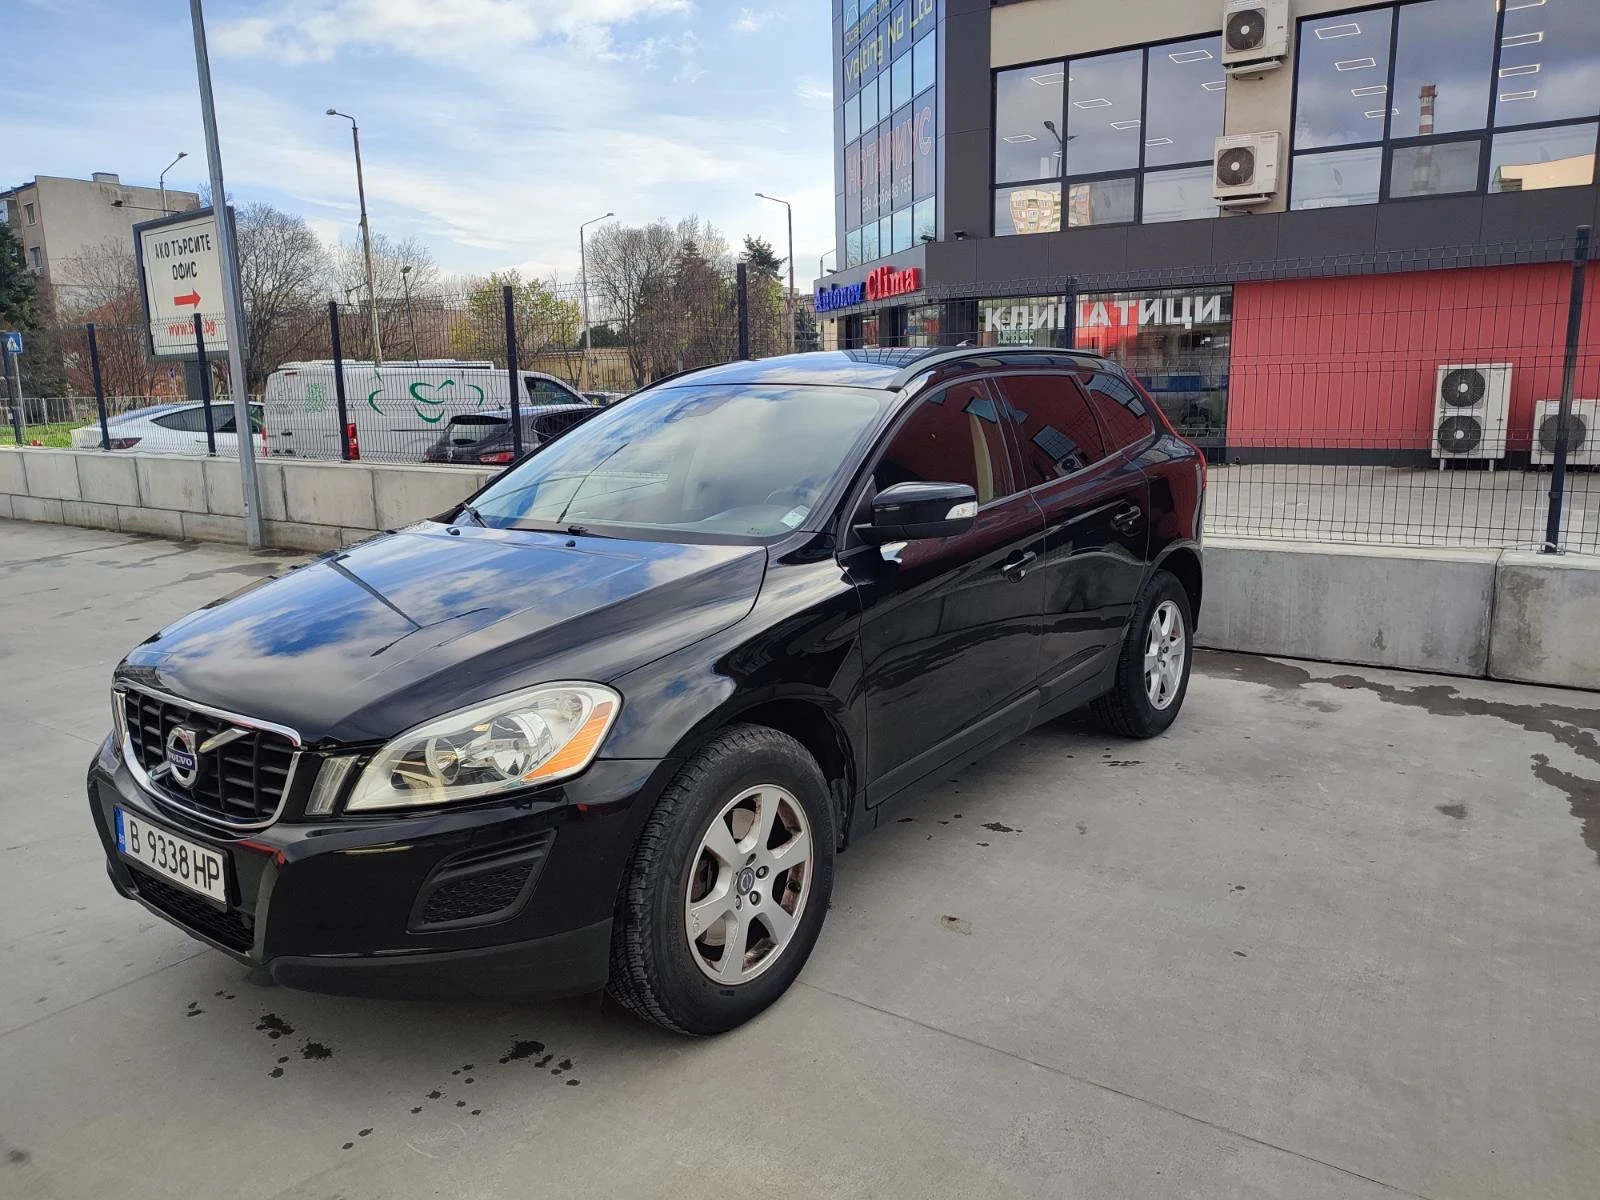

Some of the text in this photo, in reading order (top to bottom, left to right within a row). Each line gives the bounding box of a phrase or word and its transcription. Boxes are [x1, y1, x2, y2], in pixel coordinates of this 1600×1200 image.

[887, 7, 904, 49] Nd
[846, 106, 932, 197] НОТАРИУС
[155, 233, 212, 259] АКО ТЪРСИТЕ
[172, 261, 198, 280] ОФИС
[866, 265, 921, 300] Clima
[167, 751, 193, 767] VOLVO
